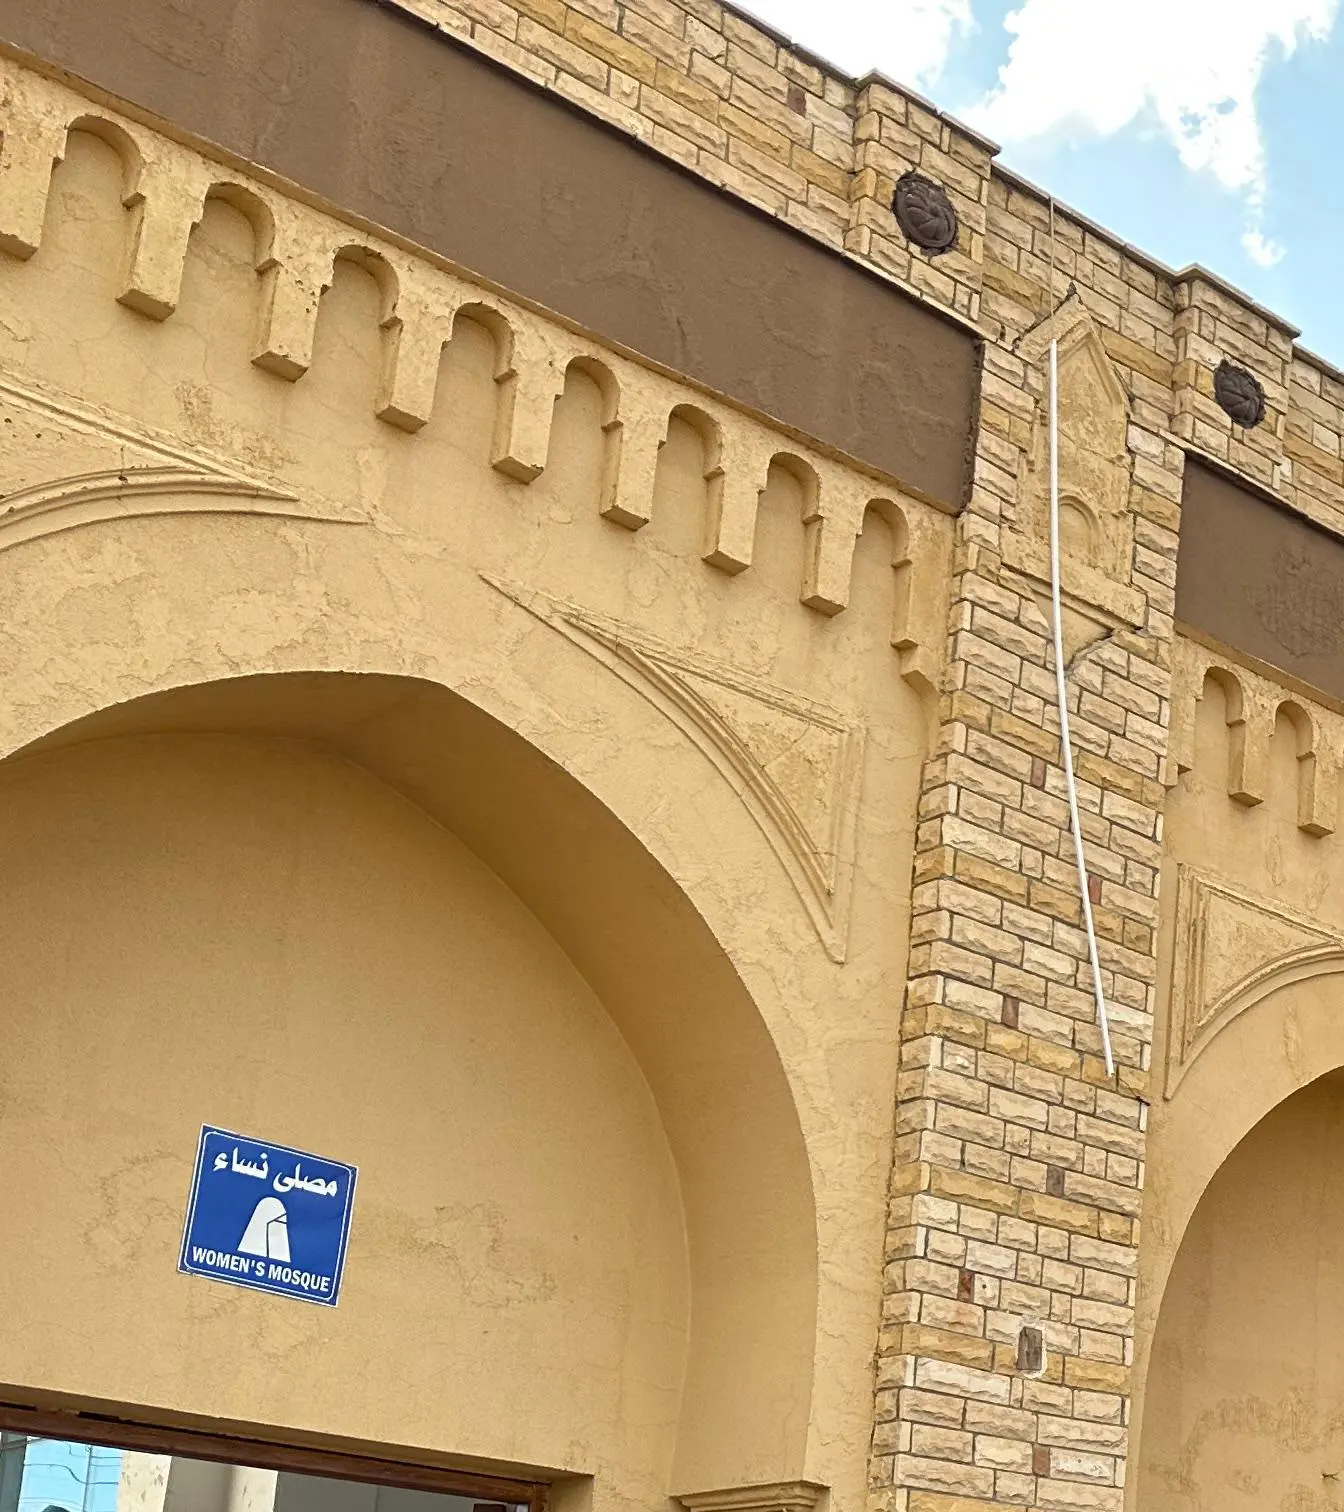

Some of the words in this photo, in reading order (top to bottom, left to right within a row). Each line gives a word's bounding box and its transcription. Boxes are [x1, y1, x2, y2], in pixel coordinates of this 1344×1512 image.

[213, 1147, 269, 1180] نساء
[273, 1163, 338, 1197] مصلى
[192, 1246, 266, 1277] WOMEN'S
[268, 1265, 330, 1292] MOSQUE
